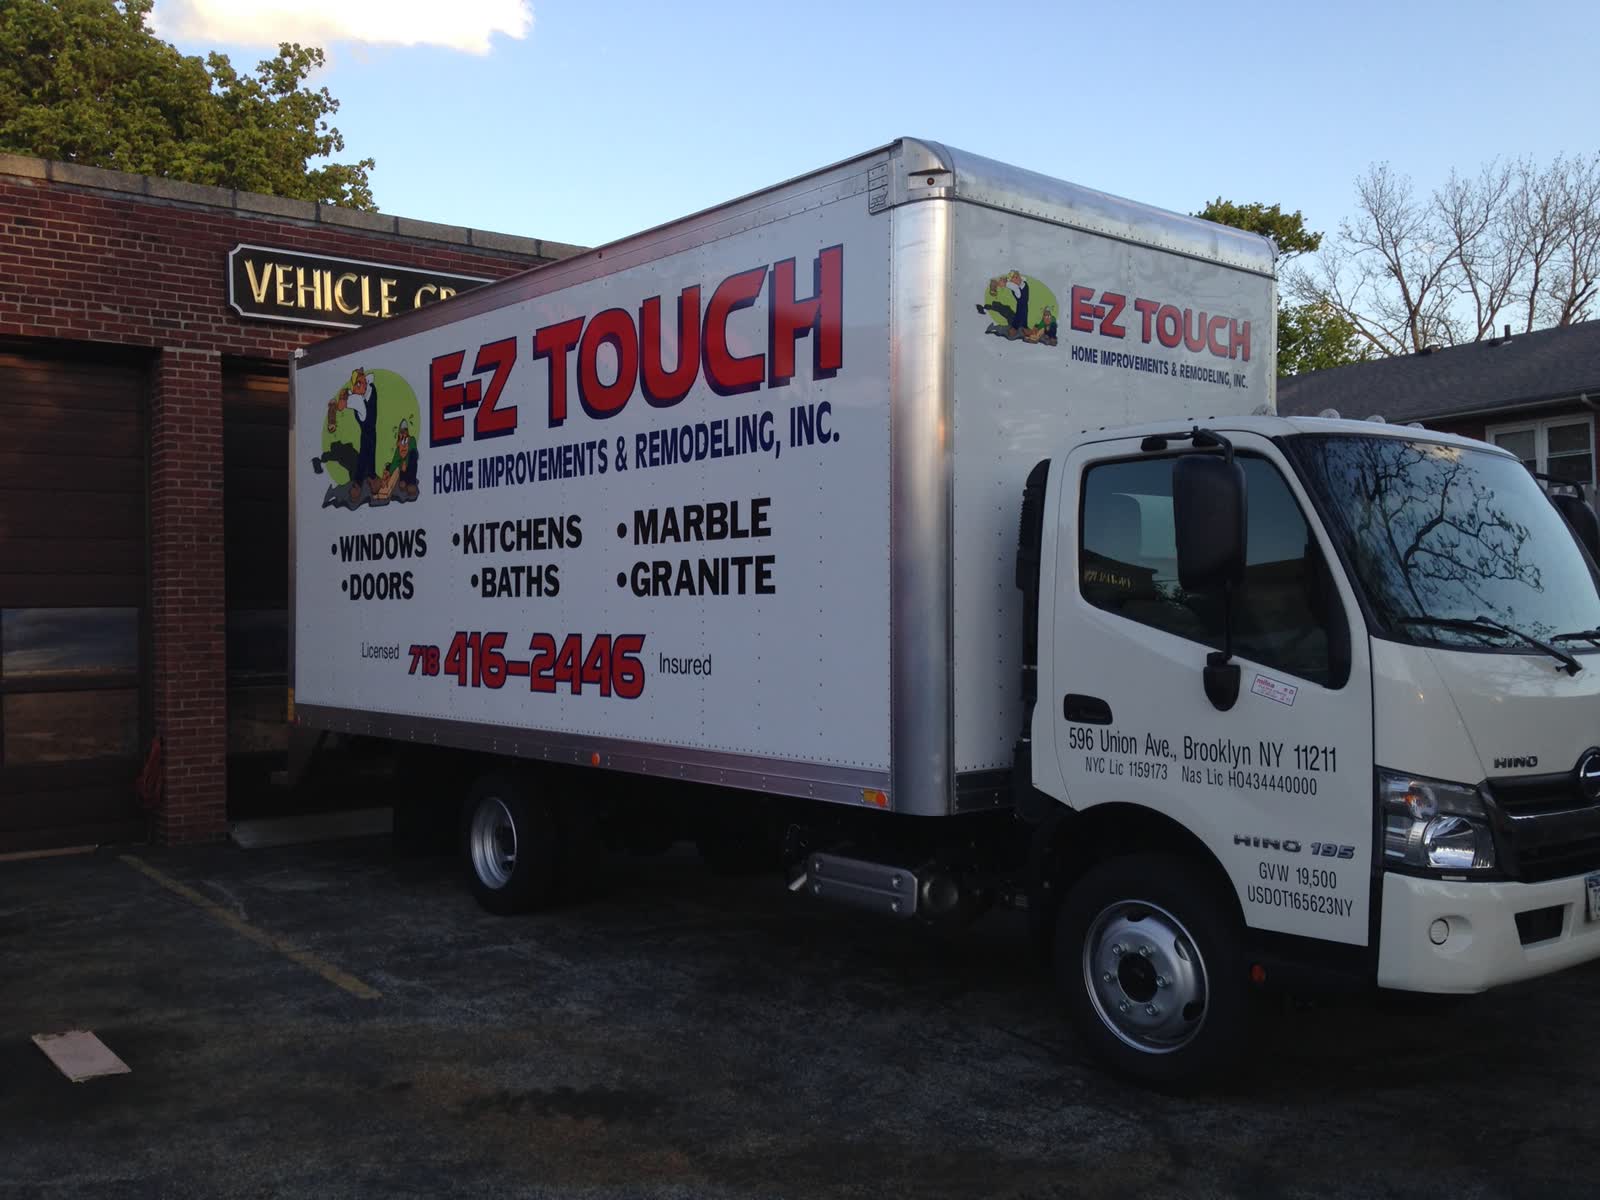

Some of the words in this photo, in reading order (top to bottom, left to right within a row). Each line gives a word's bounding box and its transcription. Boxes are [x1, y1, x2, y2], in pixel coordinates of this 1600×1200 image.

[244, 259, 398, 318] VEHICLE
[1071, 284, 1126, 339] E-Z
[1134, 297, 1251, 362] TOUCH
[429, 337, 517, 448] E-Z
[533, 244, 844, 428] TOUCH
[1071, 345, 1098, 364] HOME
[1100, 350, 1169, 376] IMPROVEMENTS
[1171, 362, 1177, 377] &
[1179, 363, 1231, 388] REMODELING,
[1233, 373, 1249, 389] INC.
[433, 460, 473, 494] HOME
[478, 438, 608, 489] IMPROVEMENTS
[615, 435, 628, 472] &
[635, 410, 781, 469] REMODELING,
[790, 401, 840, 448] INC.
[463, 514, 582, 555] KITCHENS
[633, 497, 772, 546] MARBLE
[339, 528, 428, 562] WINDOWS
[350, 570, 415, 600] DOORS
[481, 564, 560, 598] BATHS
[630, 555, 776, 598] GRANITE
[361, 641, 400, 660] Licensed
[408, 644, 440, 677] 718
[443, 631, 647, 700] 416-2446
[659, 652, 713, 677] Insured
[1069, 727, 1094, 750] 596
[1100, 729, 1137, 755] Union
[1144, 732, 1177, 762] Ave.,
[1183, 735, 1251, 769] Brooklyn
[1259, 741, 1284, 768] NY
[1294, 744, 1337, 773] 11211
[1494, 755, 1538, 769] HINO
[1085, 756, 1105, 774] NYC
[1109, 759, 1124, 776] Lic
[1128, 761, 1168, 780] 1159173
[1182, 766, 1202, 784] Nas
[1207, 768, 1223, 786] Lic
[1233, 834, 1302, 853] HINO
[1310, 841, 1356, 860] 195
[1259, 861, 1289, 882] GVW
[1296, 867, 1337, 889] 19,500
[1247, 884, 1353, 917] USDOT165623NY
